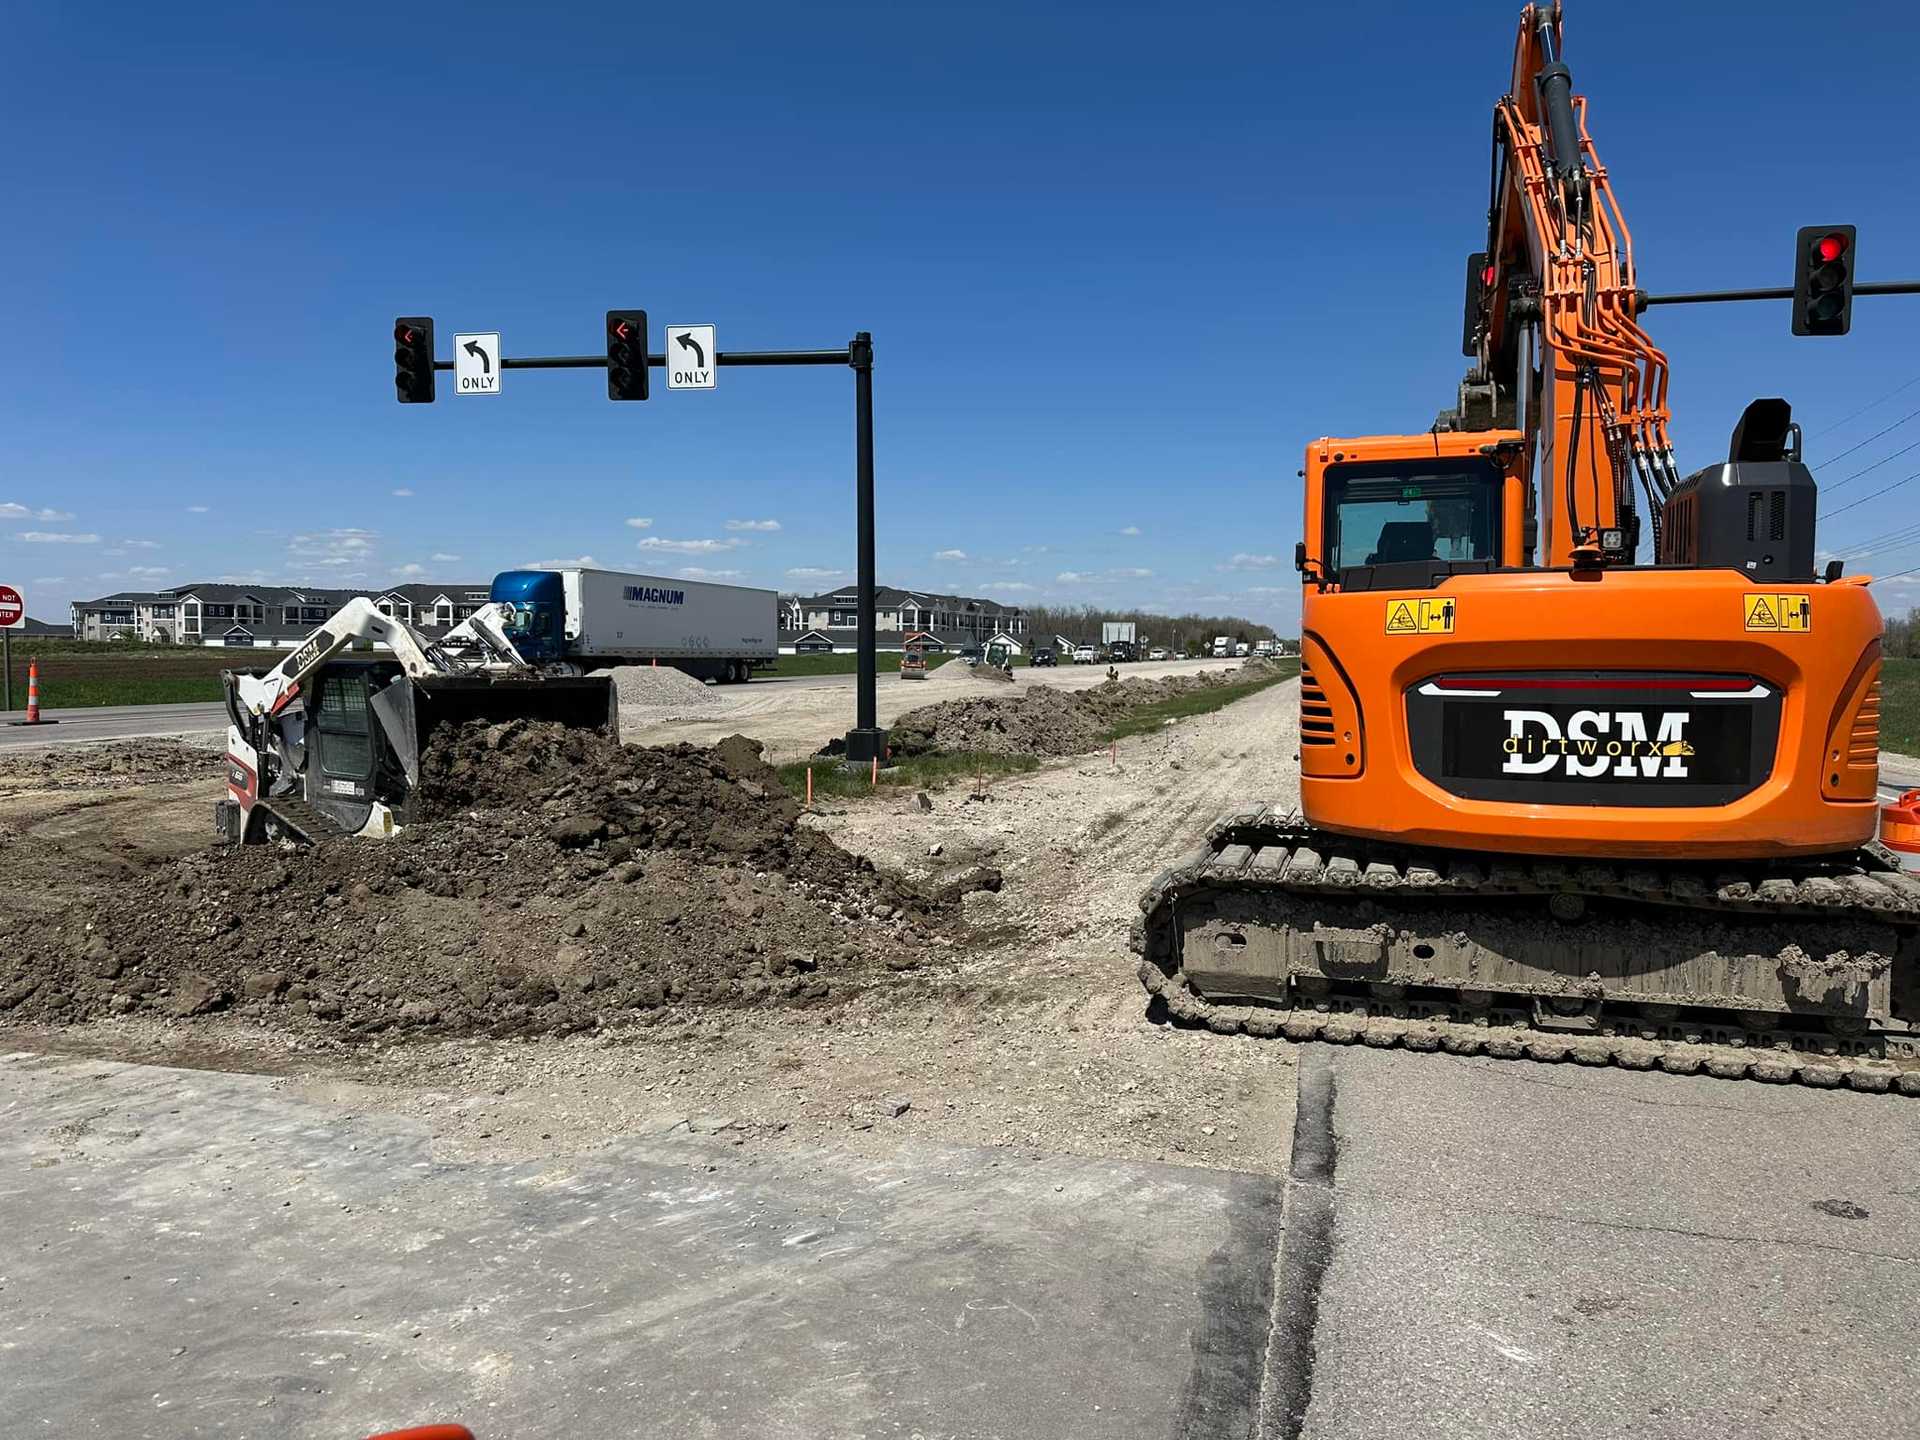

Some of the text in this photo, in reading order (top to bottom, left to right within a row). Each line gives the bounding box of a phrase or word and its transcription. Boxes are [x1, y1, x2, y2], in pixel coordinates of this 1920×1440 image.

[462, 376, 495, 389] ONLY
[674, 371, 709, 384] ONLY
[631, 586, 685, 605] MAGNUM
[0, 610, 14, 619] TER
[295, 639, 320, 671] DSM
[1502, 710, 1690, 778] DSM
[1503, 734, 1662, 757] dirtworx
